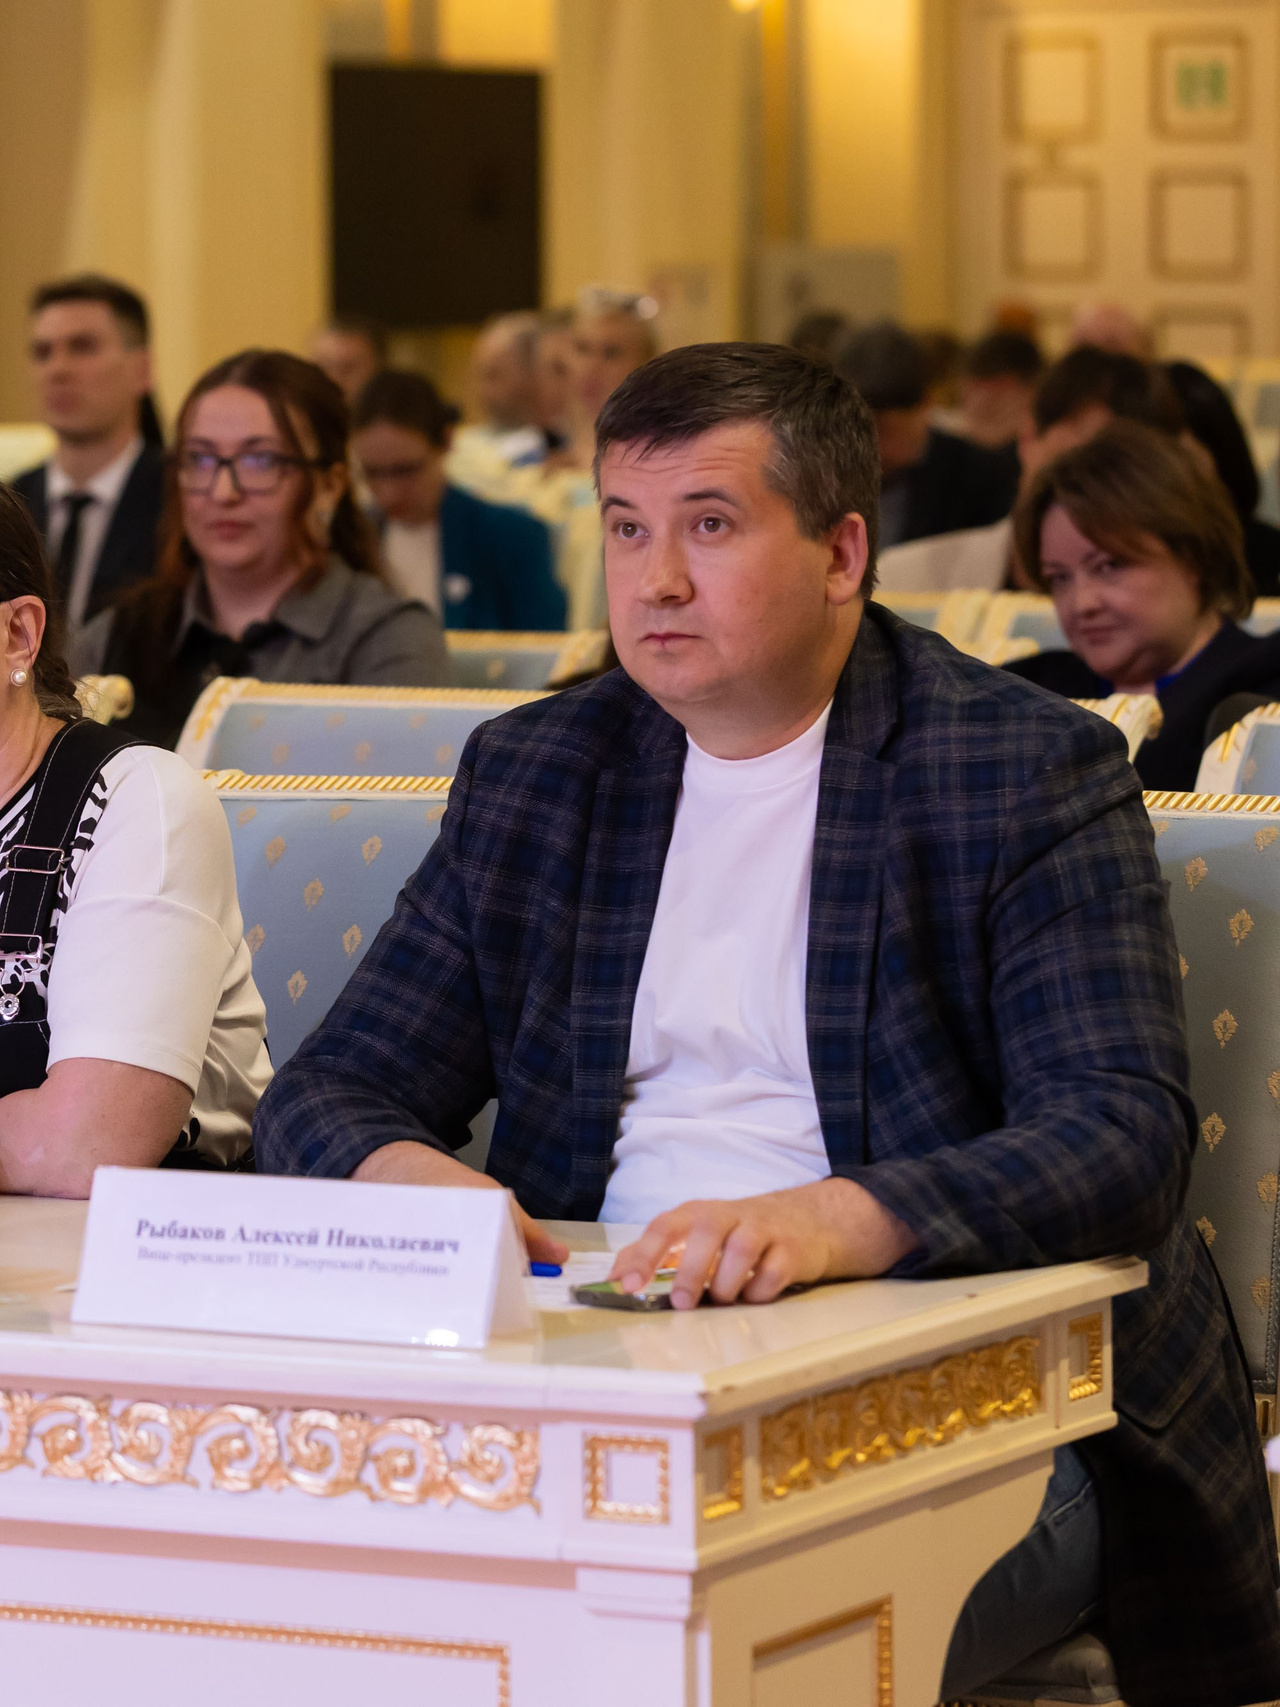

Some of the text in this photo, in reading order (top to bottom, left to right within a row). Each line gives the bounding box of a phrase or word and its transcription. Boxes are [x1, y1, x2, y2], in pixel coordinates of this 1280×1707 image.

[136, 1219, 460, 1254] Рыбаков Алексей Николаевич
